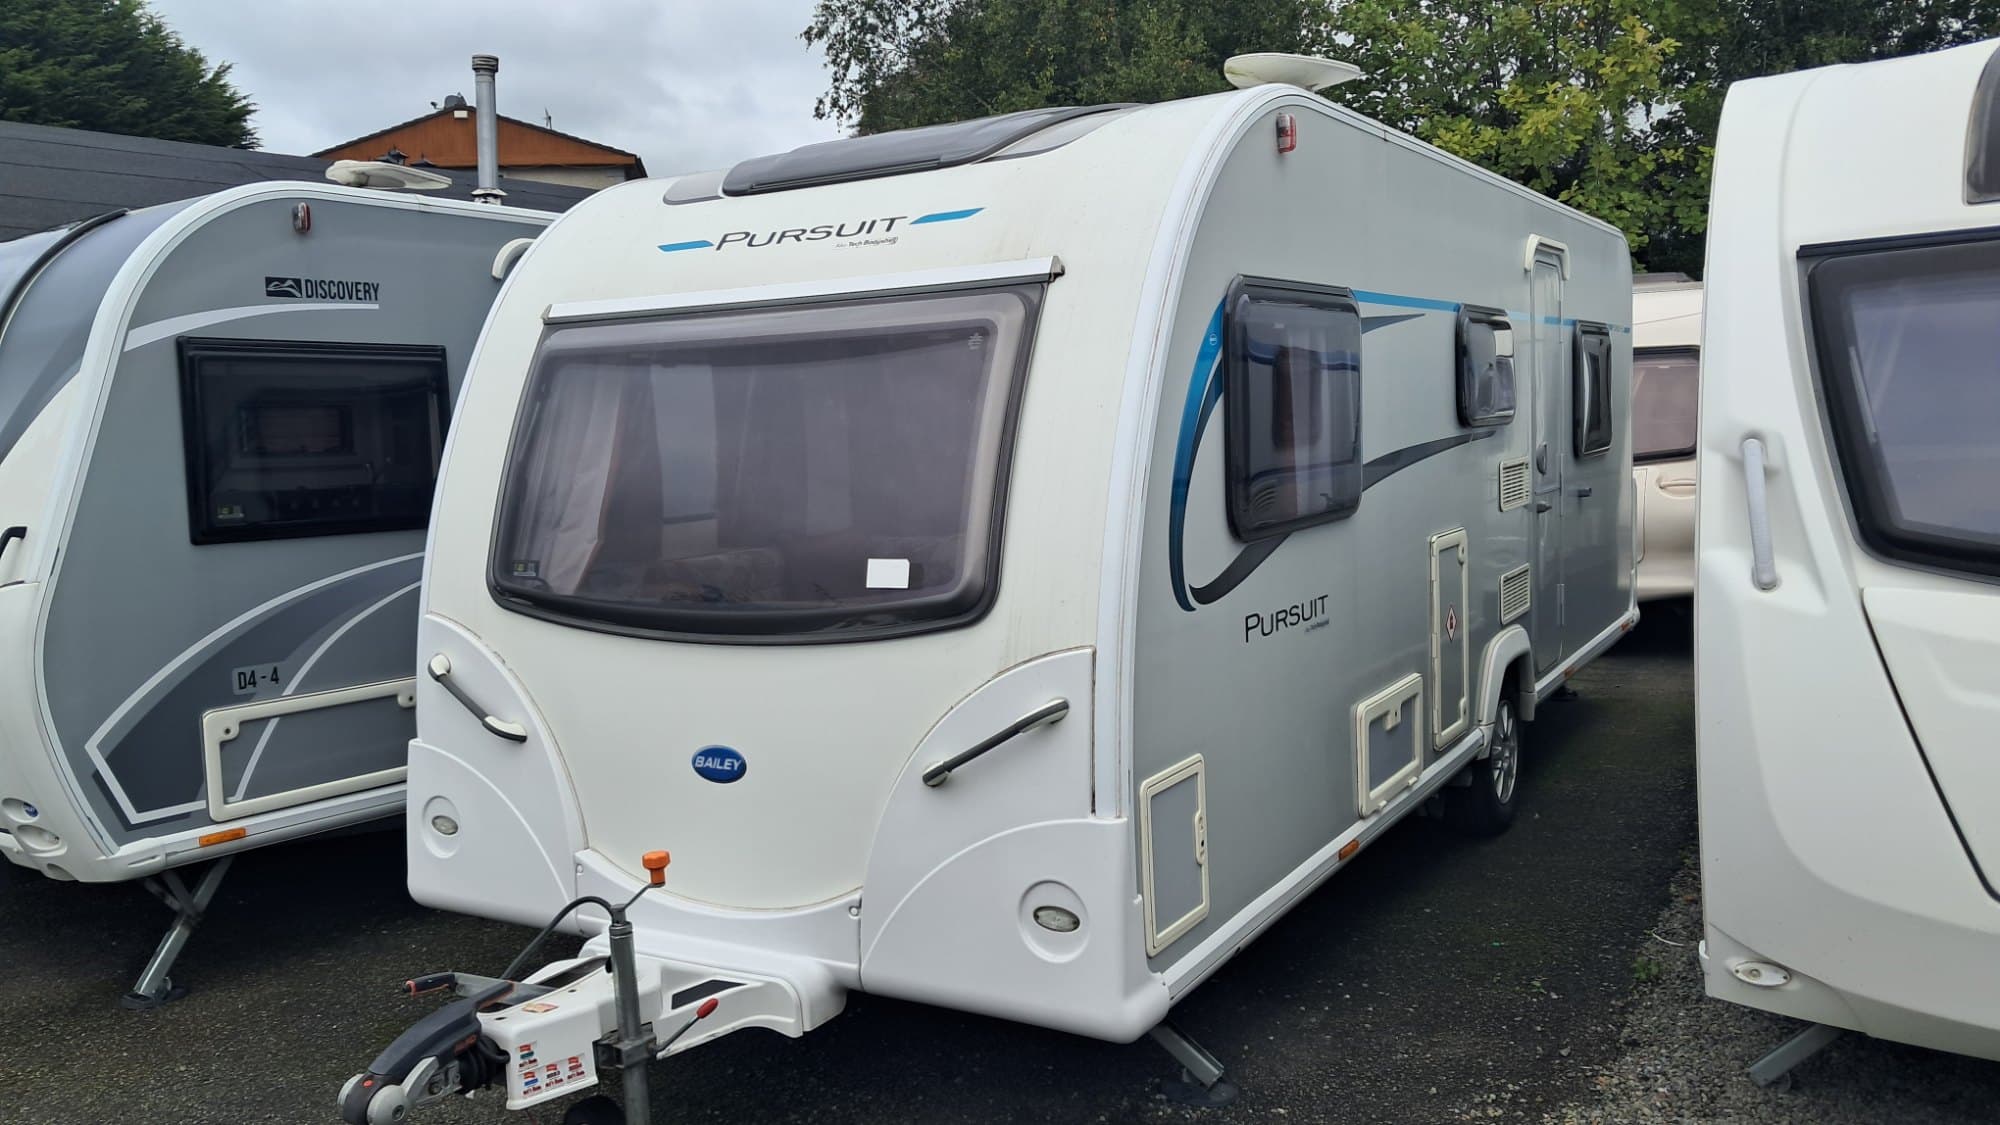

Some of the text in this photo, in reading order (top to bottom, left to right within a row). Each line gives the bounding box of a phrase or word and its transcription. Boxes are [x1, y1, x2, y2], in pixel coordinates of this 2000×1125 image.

[715, 216, 908, 251] PURSUIT
[304, 278, 380, 301] DISCOVERY
[1245, 594, 1329, 643] PURSUIT
[694, 755, 742, 771] BAILEY
